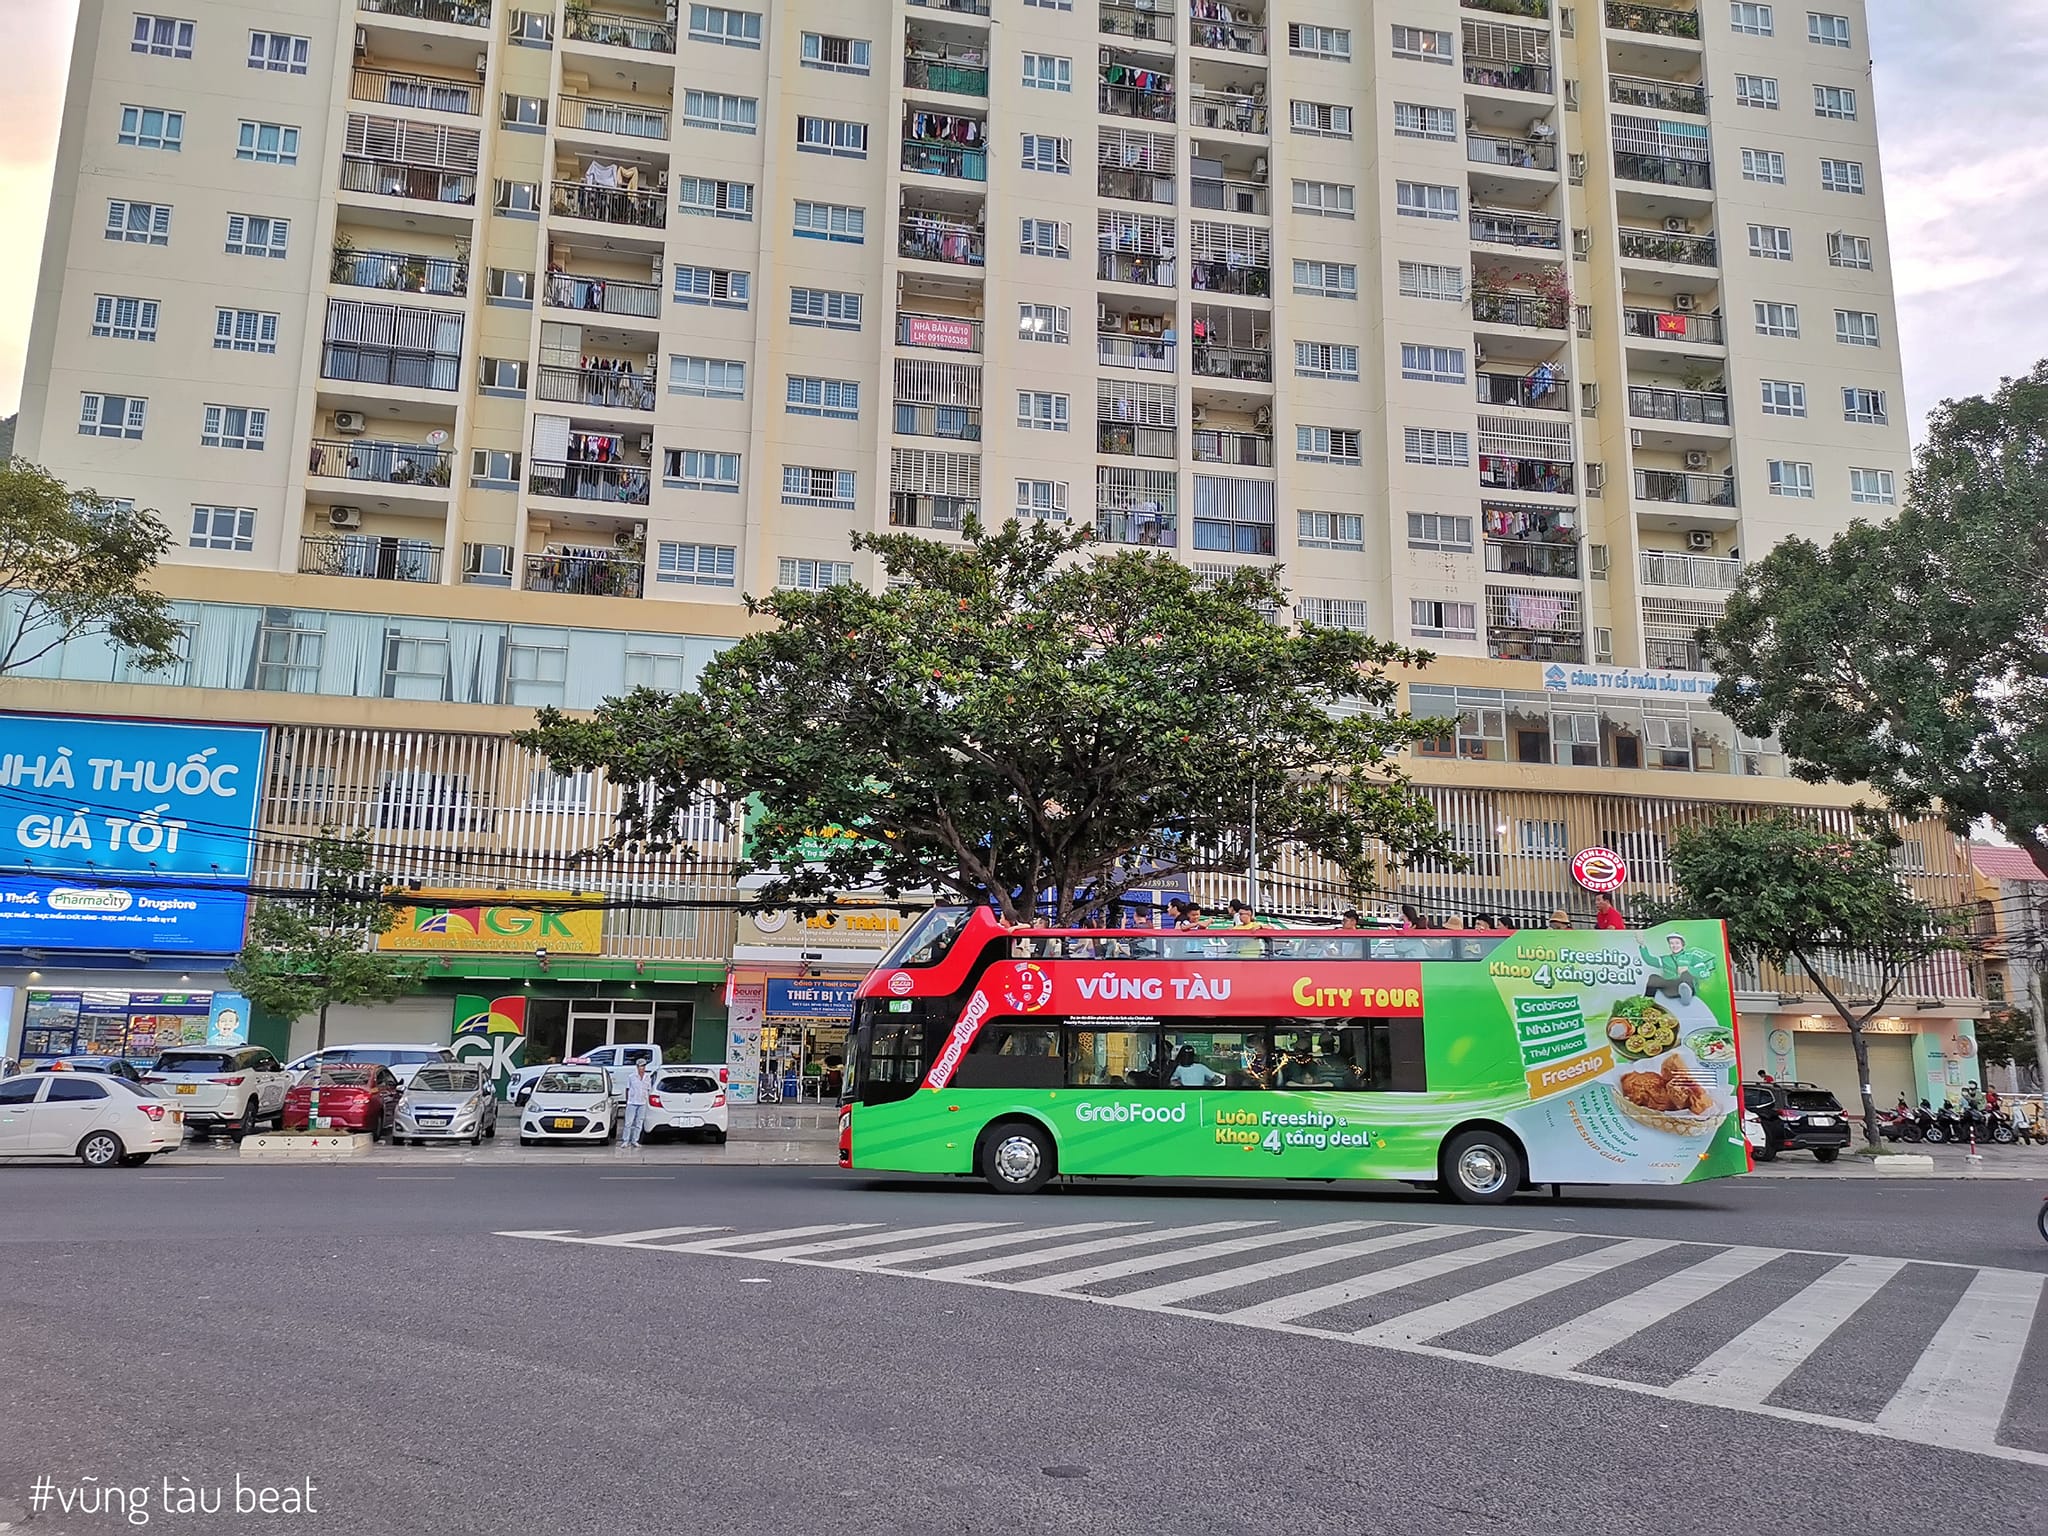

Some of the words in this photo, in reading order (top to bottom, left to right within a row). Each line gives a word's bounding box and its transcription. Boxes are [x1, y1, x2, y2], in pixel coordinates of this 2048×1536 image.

[1571, 670, 1598, 687] CÔNG
[1600, 674, 1614, 687] TY
[1615, 669, 1629, 689] CỔ
[1680, 675, 1696, 693] KHÍ
[88, 747, 239, 797] THUỐC
[17, 807, 92, 849] GIÁ
[105, 803, 188, 853] TỐT
[1575, 850, 1623, 869] HIGHLANDS
[1582, 877, 1619, 889] COFFEE
[54, 893, 126, 909] Pharmacity
[138, 897, 197, 910] Drugstore
[485, 906, 574, 937] GK
[844, 912, 900, 931] TRÀM
[1517, 945, 1556, 962] Luôn
[1560, 948, 1630, 969] Freeship
[1075, 972, 1163, 1000] VŨNG
[1170, 972, 1231, 1000] TÀU
[1489, 961, 1531, 977] Khao
[1533, 964, 1554, 988] 4
[1597, 967, 1635, 985] deal
[787, 988, 820, 1001] THIẾT
[821, 990, 833, 1003] BỊ
[835, 991, 844, 1001] Y
[846, 989, 857, 1002] T
[1292, 977, 1353, 1007] CITY
[1360, 988, 1420, 1007] TOUR
[1521, 999, 1577, 1013] GrabFood
[1525, 1023, 1551, 1036] Nhà
[1552, 1018, 1579, 1033] hàng
[931, 1062, 949, 1086] Hop
[947, 1047, 958, 1060] on
[957, 1016, 975, 1041] Hop
[970, 993, 986, 1016] Off
[1560, 1039, 1583, 1051] Moca
[450, 1035, 527, 1079] GK
[1541, 1056, 1603, 1087] Freeship
[1076, 1102, 1185, 1123] GrabFood
[1216, 1109, 1258, 1125] Luôn
[1262, 1111, 1335, 1129] Freeship
[1338, 1117, 1348, 1127] &
[1567, 1099, 1601, 1151] FREESHIP
[1215, 1128, 1260, 1144] Khao
[1262, 1129, 1283, 1154] 4
[1285, 1129, 1326, 1149] tầng
[1330, 1131, 1369, 1147] deal
